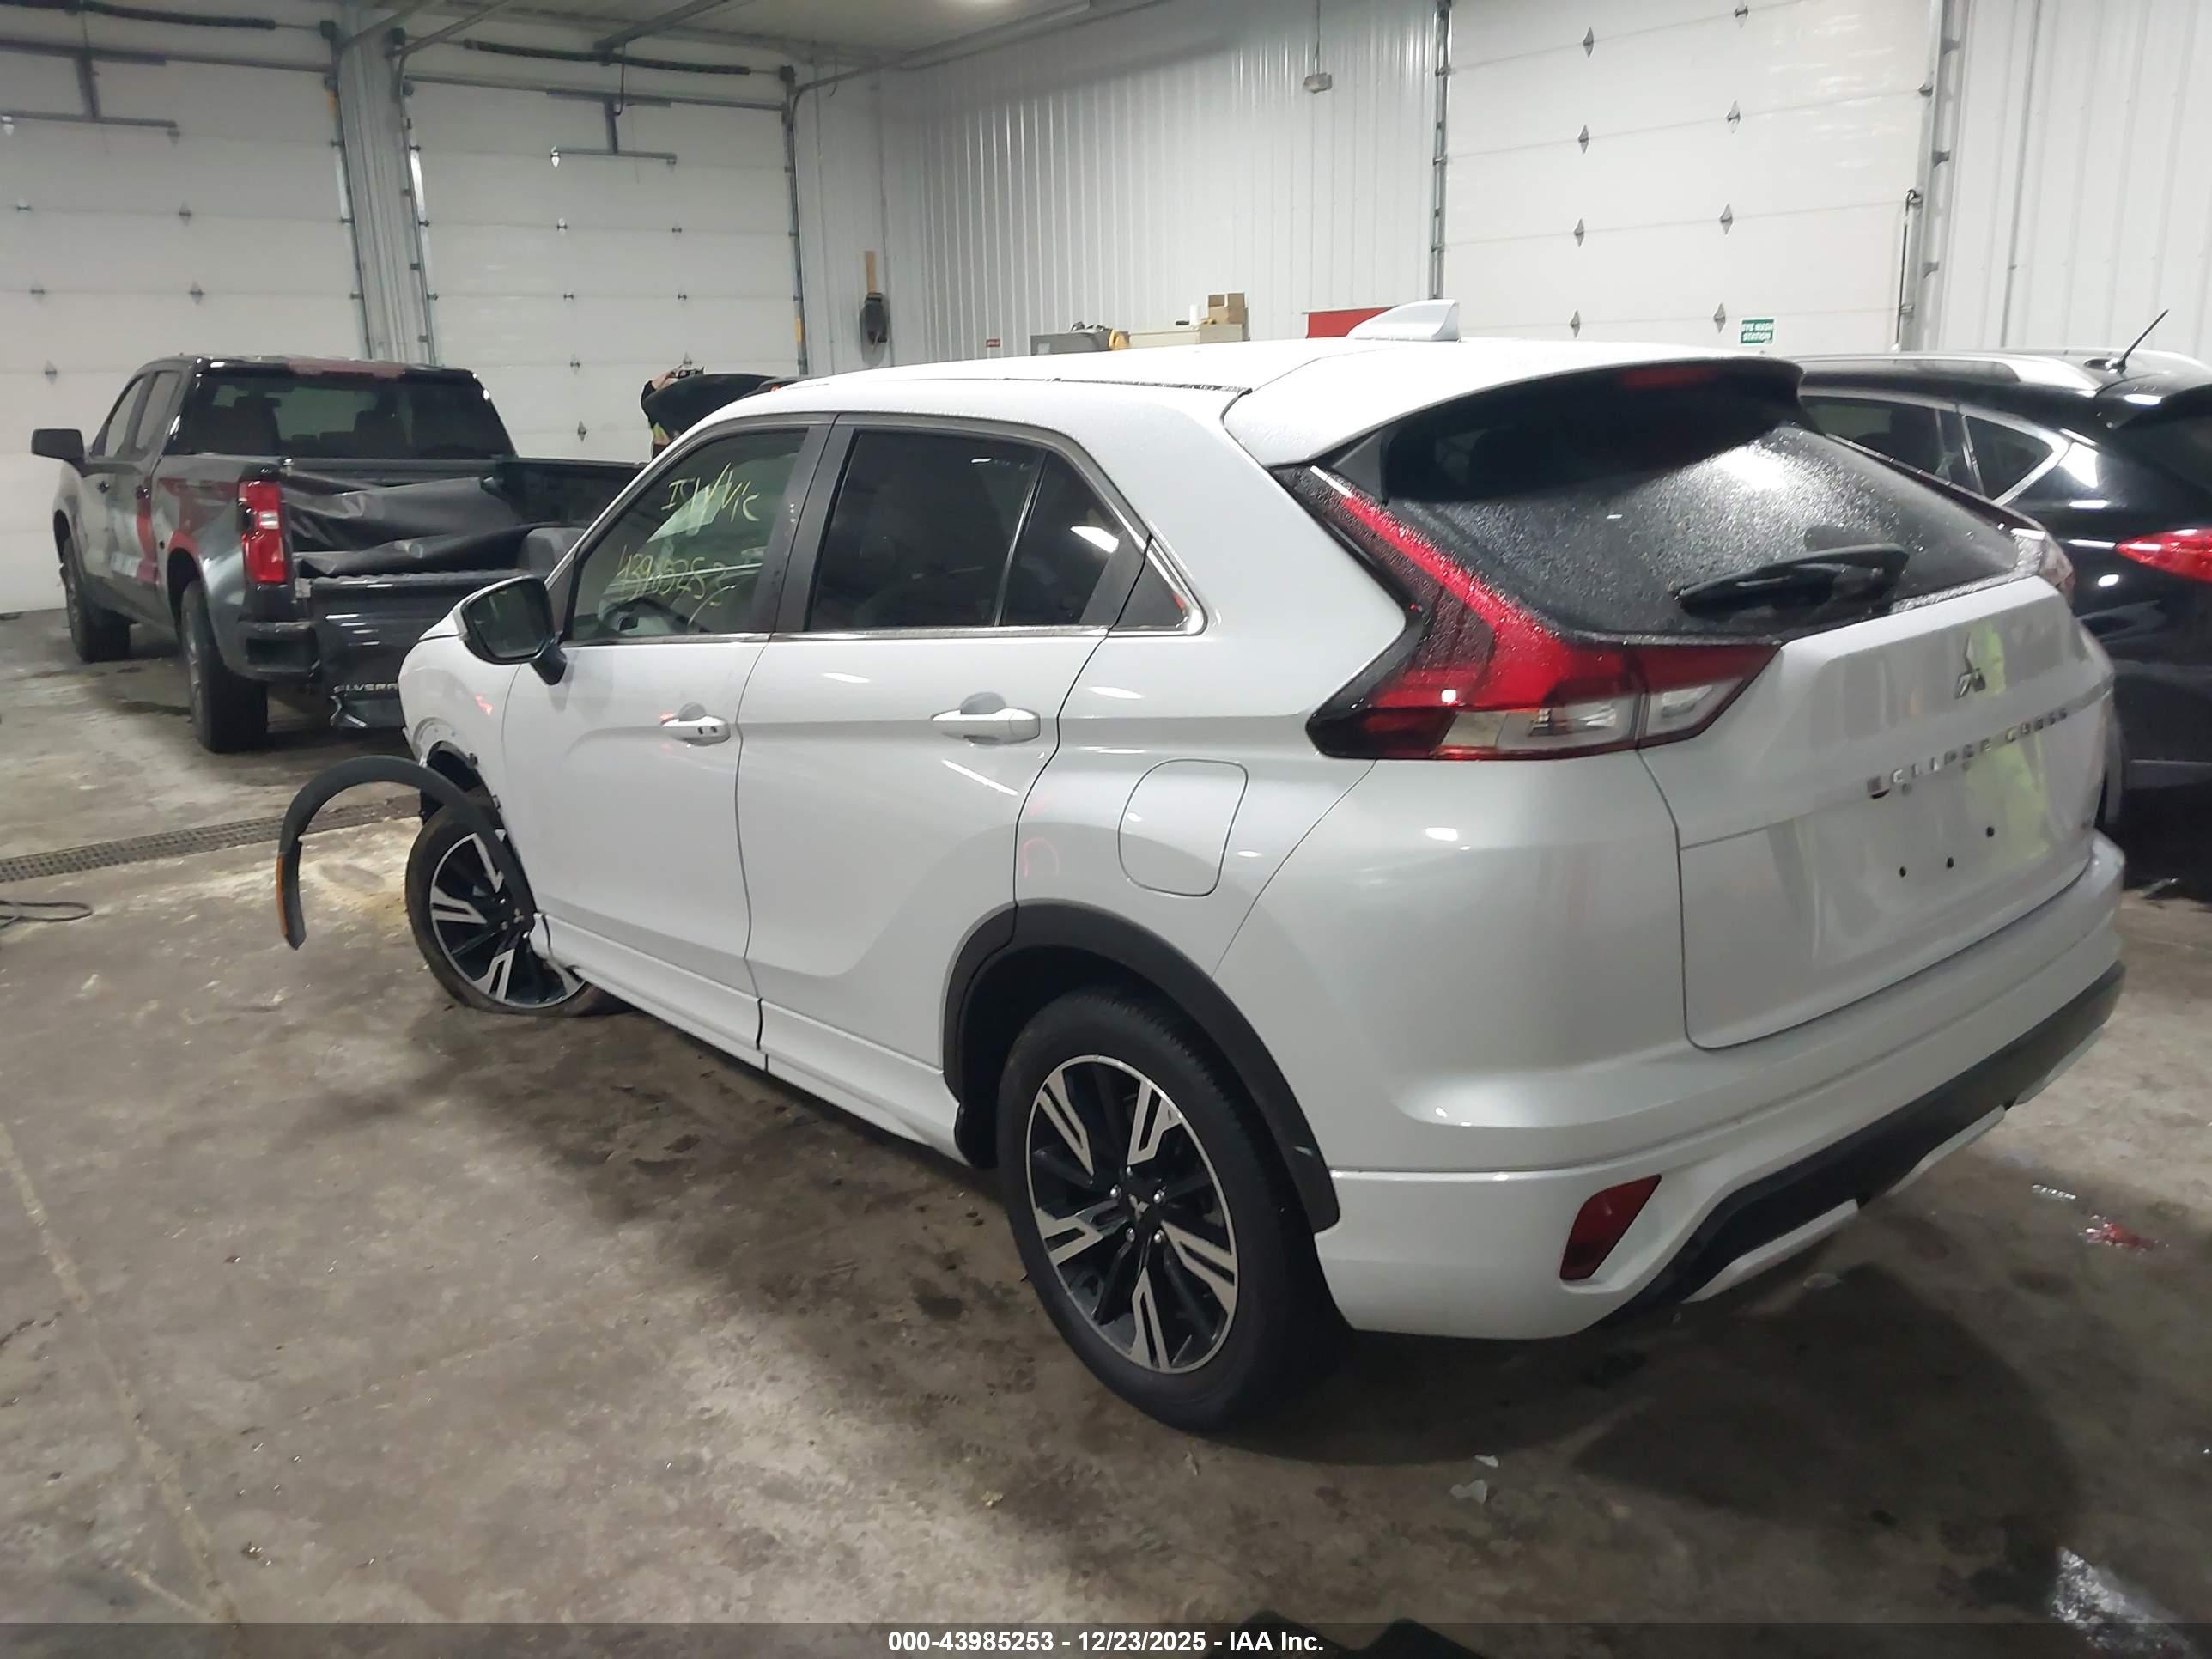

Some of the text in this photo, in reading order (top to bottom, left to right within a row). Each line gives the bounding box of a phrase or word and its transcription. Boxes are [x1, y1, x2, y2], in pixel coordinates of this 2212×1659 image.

[1742, 331, 1771, 341] STATION
[1867, 708, 2068, 798] ECLIPSE CROSS
